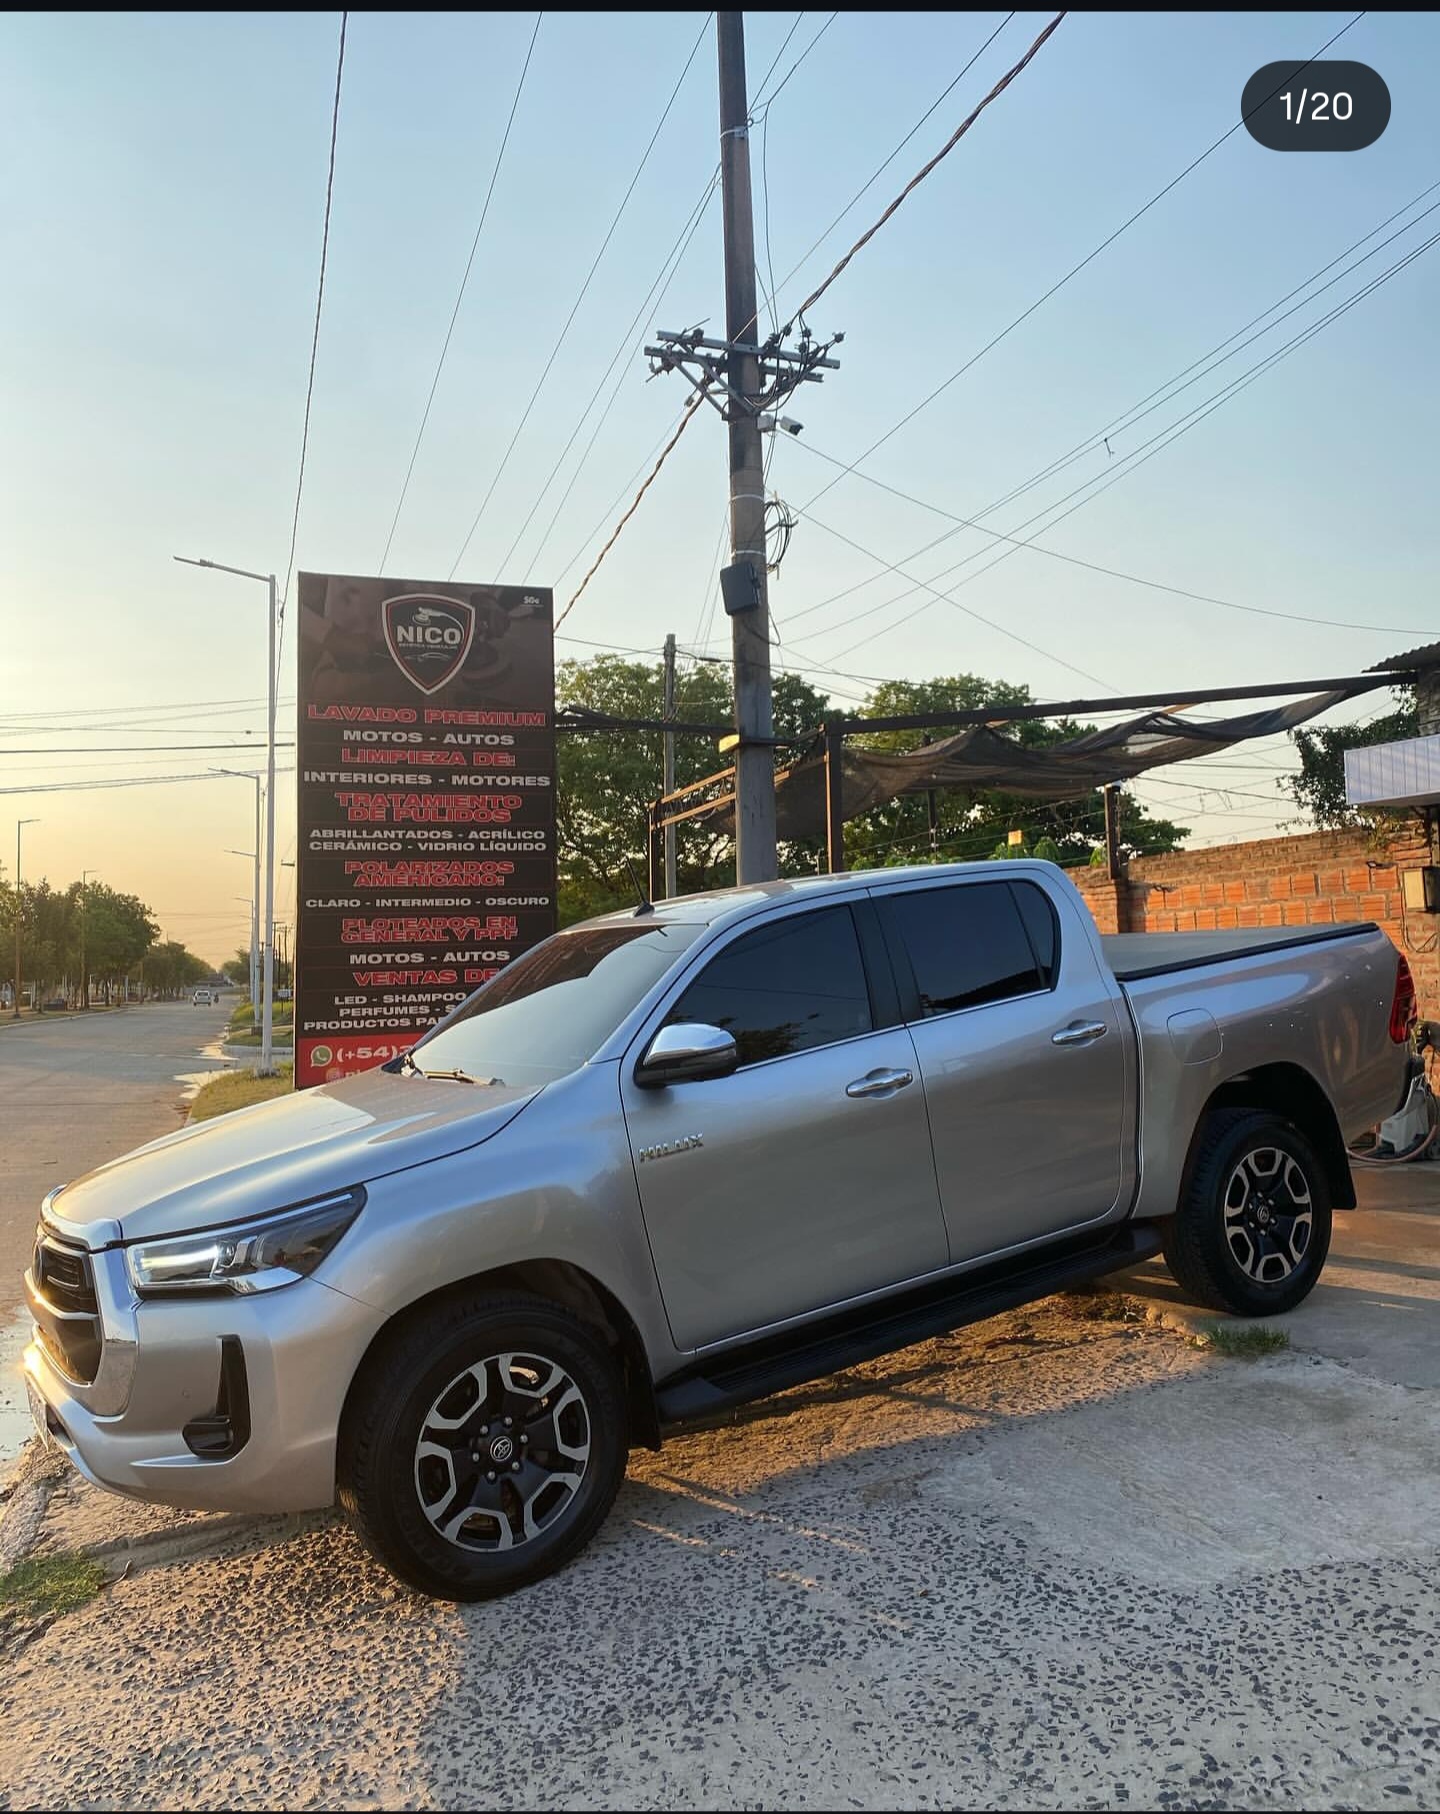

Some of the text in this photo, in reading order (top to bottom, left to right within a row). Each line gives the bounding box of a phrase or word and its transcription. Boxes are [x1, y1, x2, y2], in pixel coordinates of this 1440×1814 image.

[396, 625, 462, 645] NICO
[308, 704, 546, 726] LAVADO PREMIUM
[343, 730, 423, 743] MOTOS
[443, 733, 515, 745] AUTOS
[341, 748, 466, 765] LIMPIEZA
[304, 771, 432, 785] INTERIORES
[451, 775, 550, 786] MOTORES
[335, 793, 522, 809] TRATAMIENTO
[348, 808, 511, 822] DE PULIDOS
[310, 829, 453, 839] ABRILLANTADOS
[468, 829, 545, 840] ACRÍLICO
[310, 840, 402, 851] CERÁMICO
[417, 843, 475, 851] VIDRIO
[480, 840, 546, 852] LÍQUIDO
[345, 861, 514, 874] POLARIZADOS
[353, 873, 505, 887] AMERICANO:
[306, 899, 361, 908] CLARO
[376, 898, 471, 907] INTERMEDIO
[486, 897, 549, 906] OSCURO
[343, 916, 516, 930] PLOTEADOS EN
[341, 928, 518, 943] GENERAL Y PPF
[350, 953, 425, 964] MOTOS
[443, 951, 510, 962] AUTOS
[353, 970, 457, 986] VENTAS
[334, 994, 368, 1004] LED
[383, 993, 467, 1003] SHAMPOO
[339, 1006, 430, 1016] PERFUMES
[304, 1018, 411, 1030] PRODUCTOS
